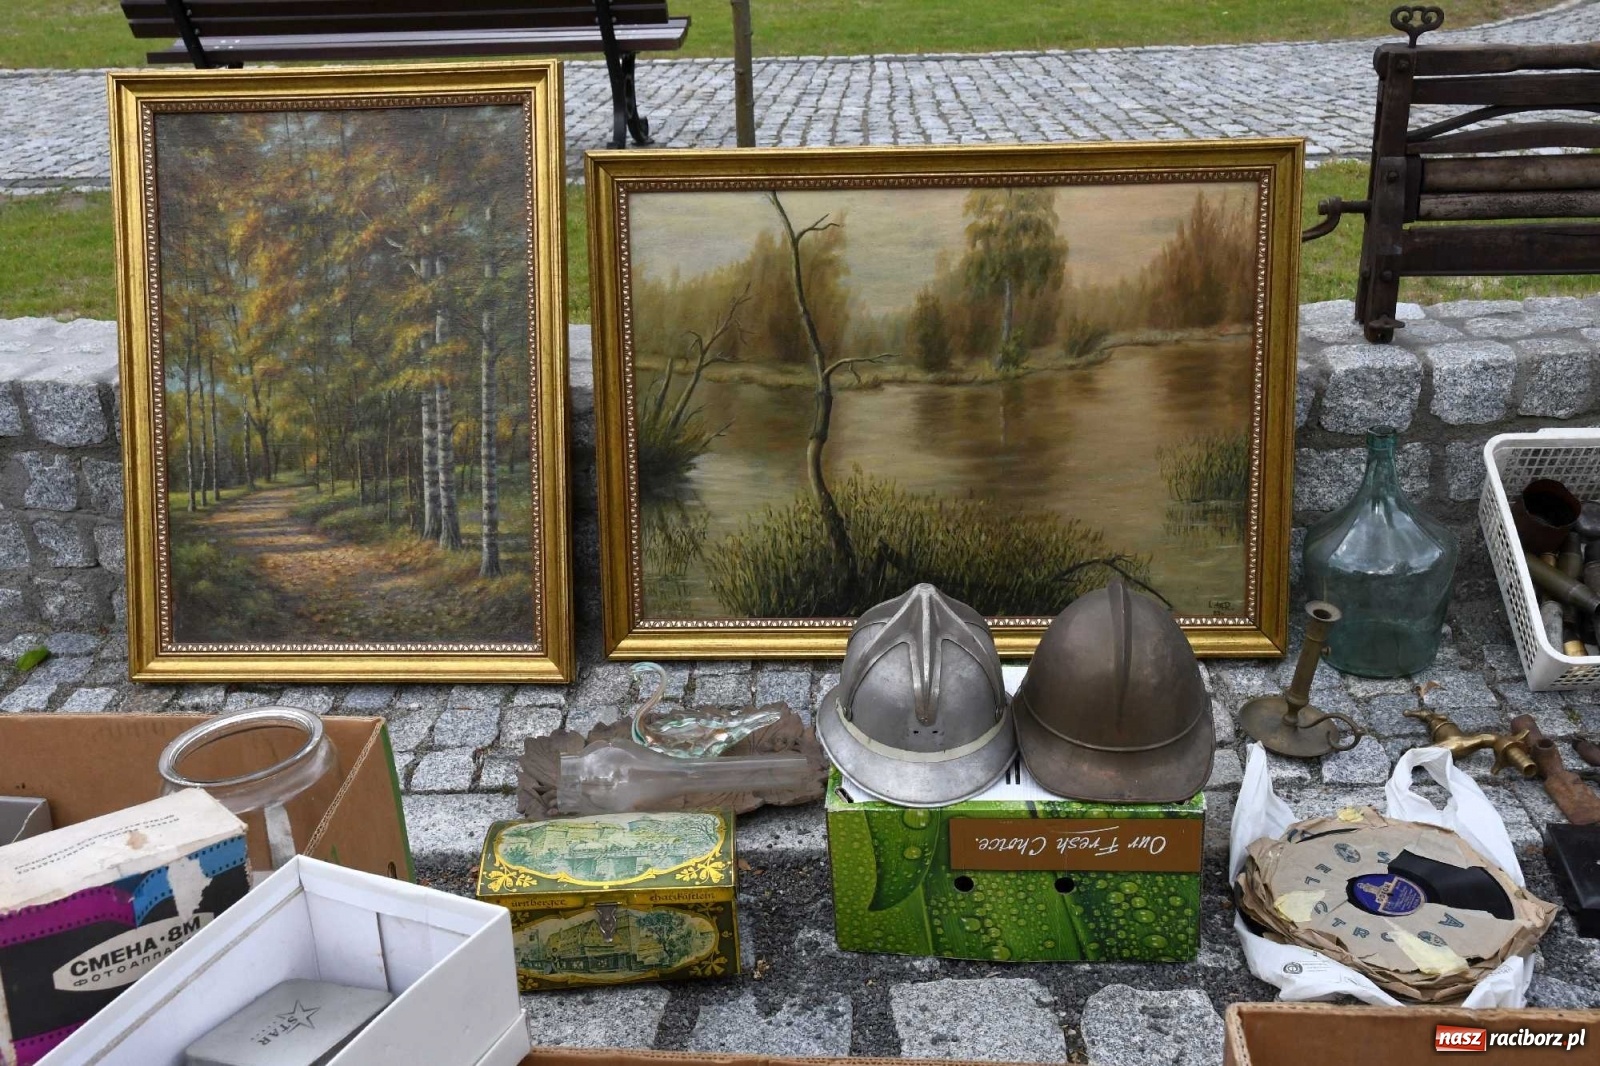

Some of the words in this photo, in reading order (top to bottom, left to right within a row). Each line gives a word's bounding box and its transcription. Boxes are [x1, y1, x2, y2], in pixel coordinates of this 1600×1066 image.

[975, 836, 1047, 856] Choice.
[1056, 836, 1119, 857] Fresh
[1127, 835, 1166, 855] Our
[257, 1015, 298, 1046] STAR
